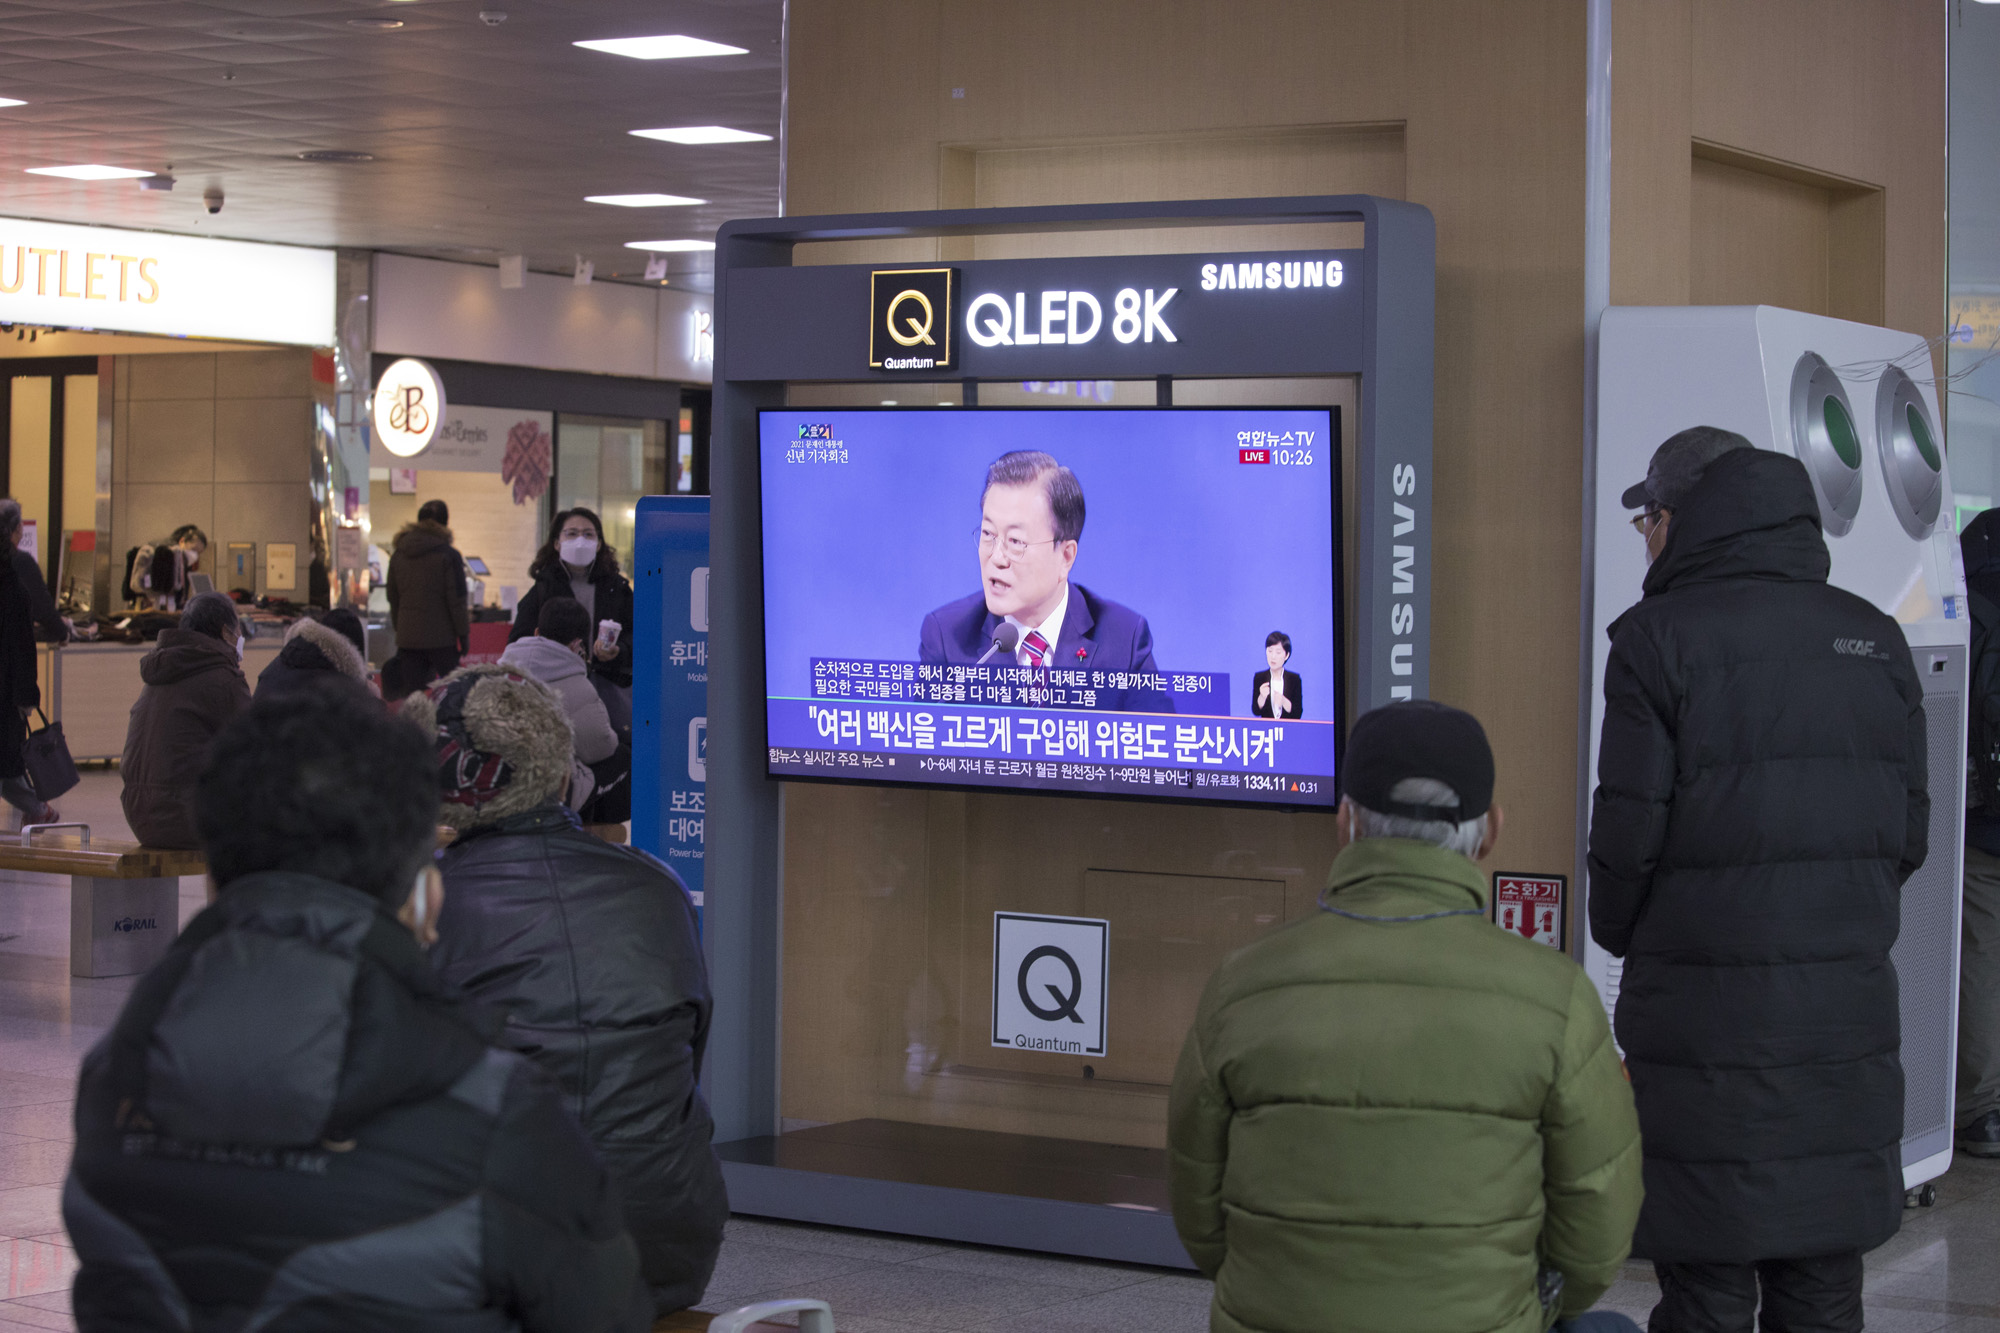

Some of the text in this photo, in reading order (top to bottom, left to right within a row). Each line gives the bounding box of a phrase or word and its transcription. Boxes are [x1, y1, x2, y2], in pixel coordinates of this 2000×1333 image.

[0, 245, 159, 304] UTLETS
[1201, 260, 1343, 291] SAMSUNG
[886, 289, 936, 346] Q
[966, 288, 1178, 347] QLED 8K
[884, 357, 933, 369] Quantum
[1237, 430, 1315, 447] 연합뉴스TV
[785, 449, 848, 464] 신년 기자회견
[1245, 450, 1313, 465] LIVE 10:26
[1391, 463, 1415, 702] SAMSU
[669, 641, 708, 666] 휴대
[814, 661, 1212, 693] 순차적으로 도입을 해서 2월부터 시작해서 대체로 한 9월까지는 접종이
[815, 679, 851, 696] 필요한
[854, 680, 903, 698] 국민들의
[907, 682, 925, 699] 1차
[929, 683, 966, 701] 접종을
[970, 685, 982, 702] 다
[987, 686, 1012, 703] 마칠
[1016, 687, 1067, 706] 계획이고
[809, 706, 1284, 767] "여러 백신을 고르게 구입해 위험도 분산시켜"
[769, 748, 884, 768] 합뉴스 실시간 주요 뉴스
[927, 757, 1192, 786] 0~6세 자녀 둔 근로자 월급 원천징수 1~9만원 늘어난
[1196, 772, 1240, 788] 원/유로화
[1243, 775, 1286, 791] 1334.11
[670, 790, 706, 813] 보조
[669, 817, 704, 844] 대여
[669, 848, 691, 858] Power
[1502, 882, 1556, 897] 소화기
[1017, 945, 1085, 1024] Q
[1015, 1034, 1081, 1053] Quantum
